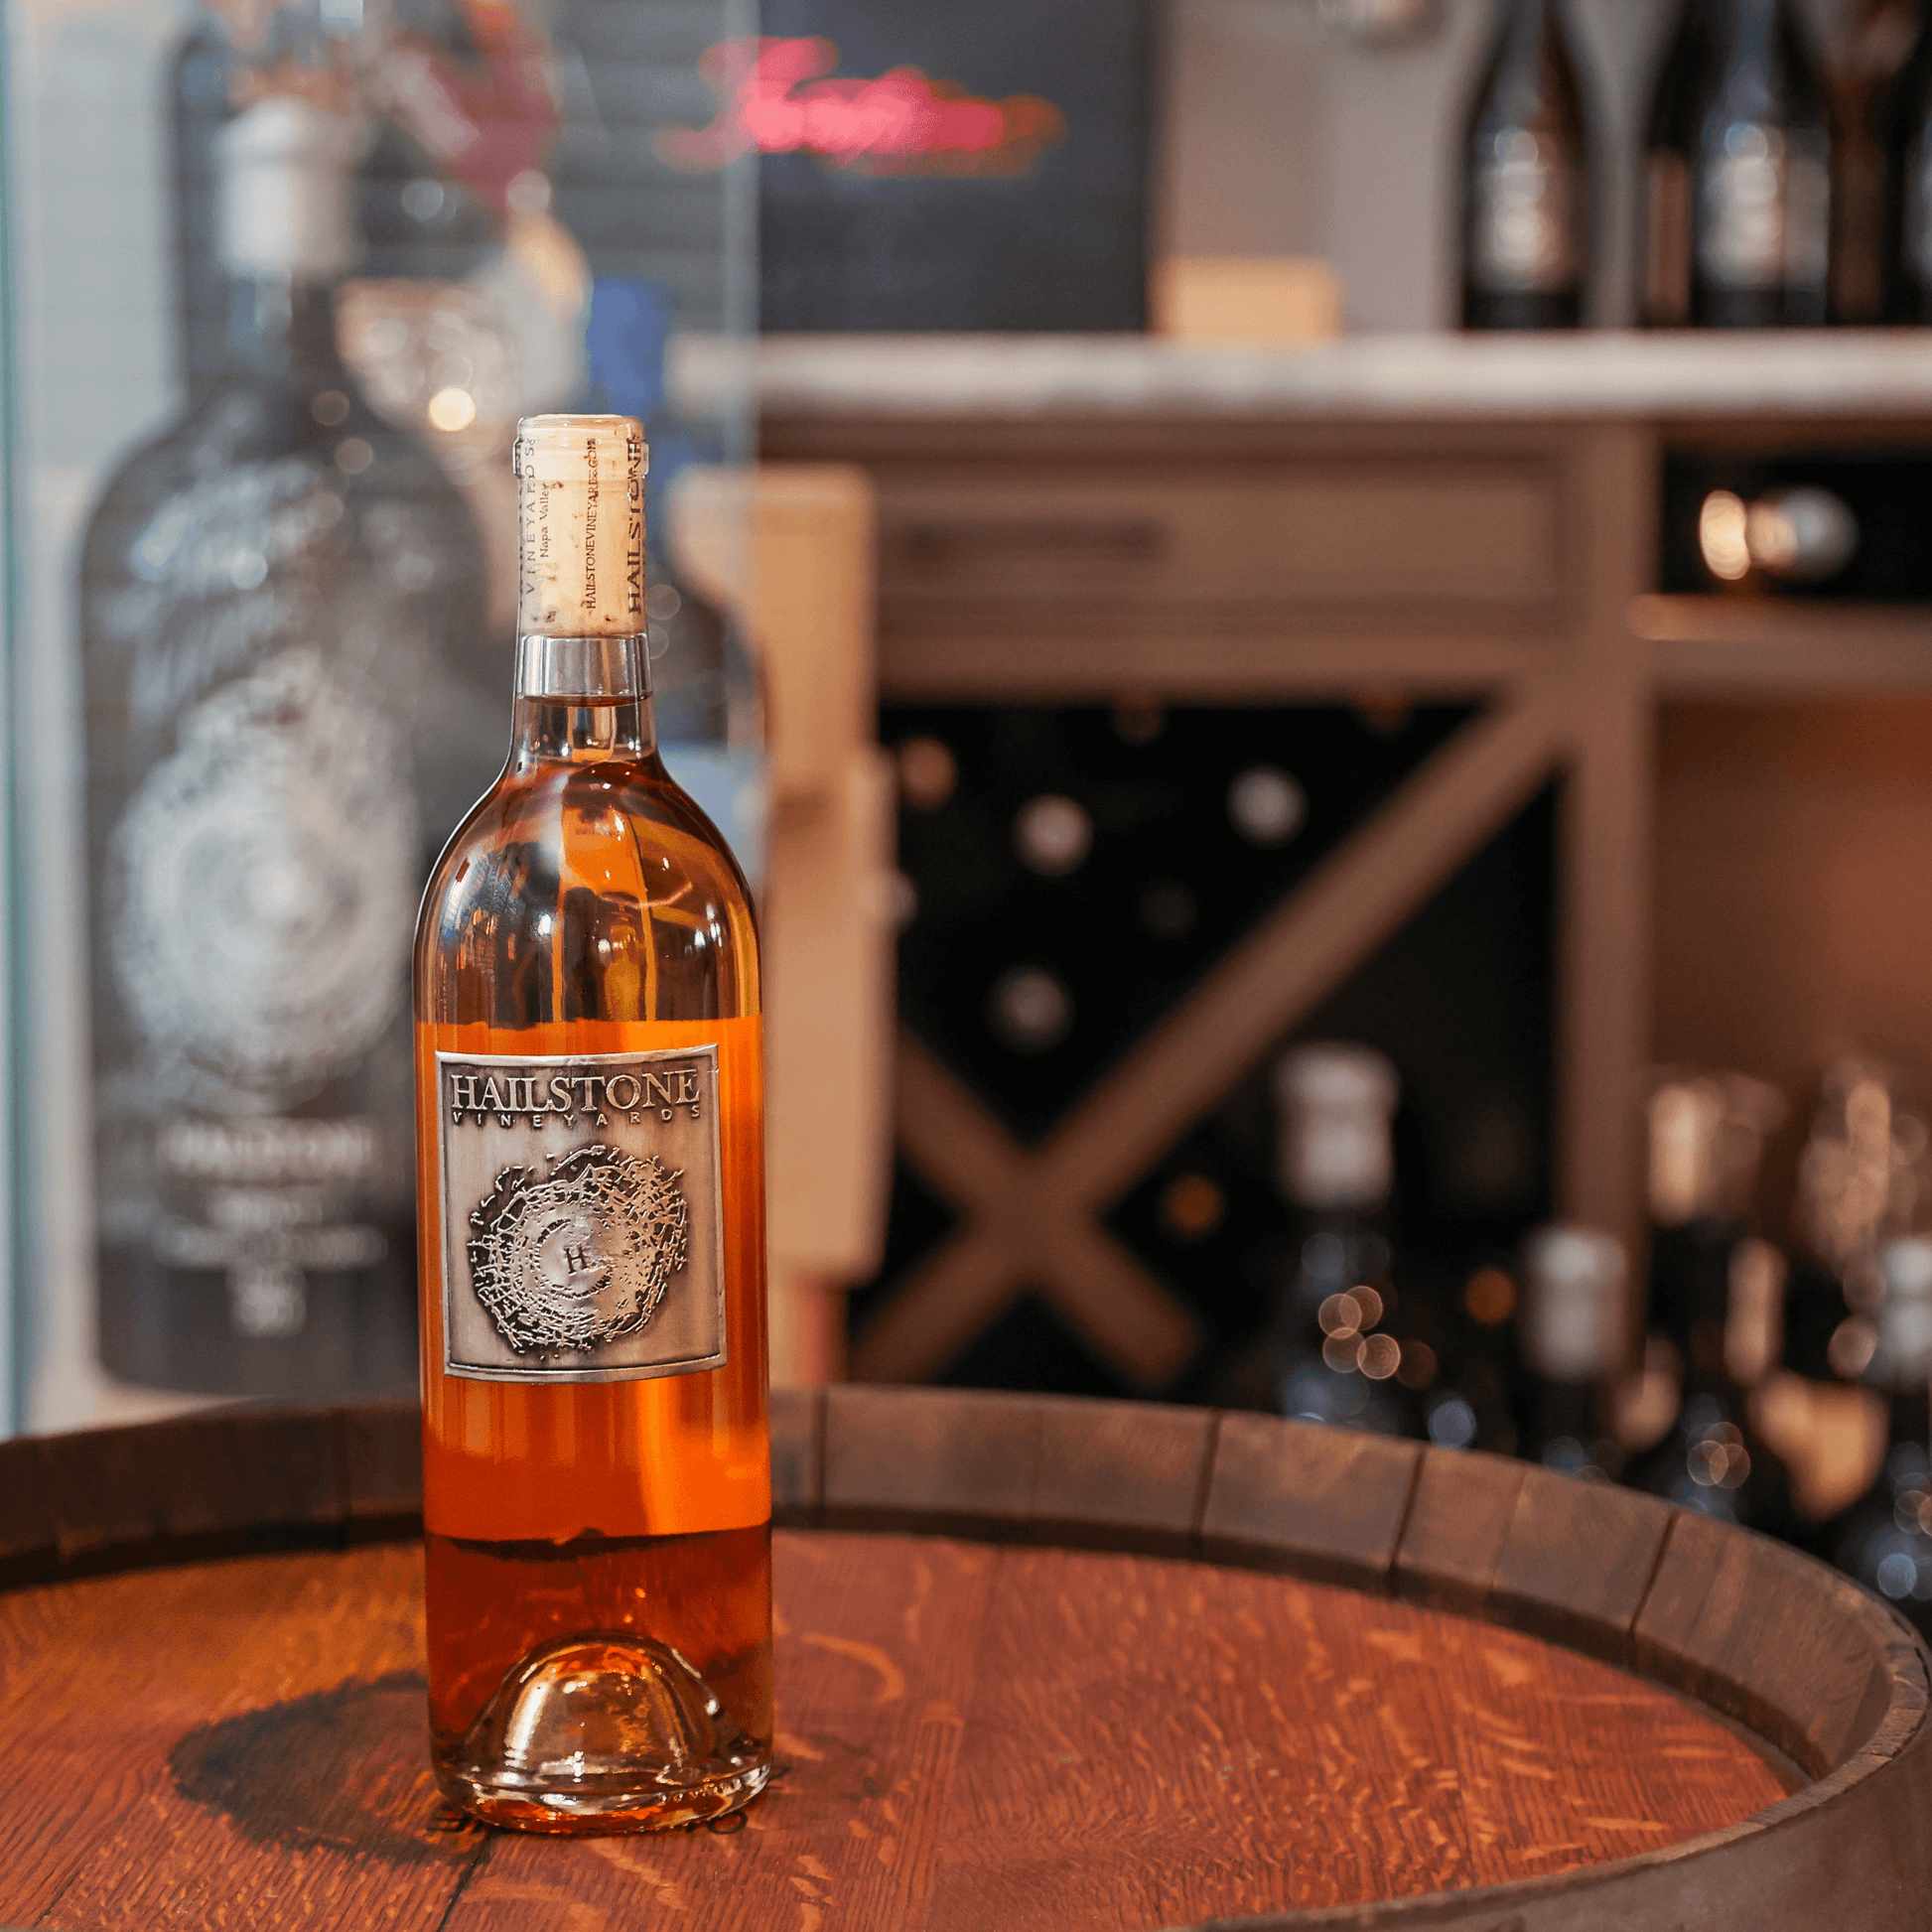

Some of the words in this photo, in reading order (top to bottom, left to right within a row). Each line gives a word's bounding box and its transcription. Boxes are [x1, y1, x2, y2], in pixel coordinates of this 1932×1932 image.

[539, 481, 552, 520] Valley
[539, 526, 552, 558] Napa
[450, 1068, 700, 1113] HAILSTONE
[453, 1104, 700, 1129] VINEYARDS
[563, 1243, 590, 1275] H
